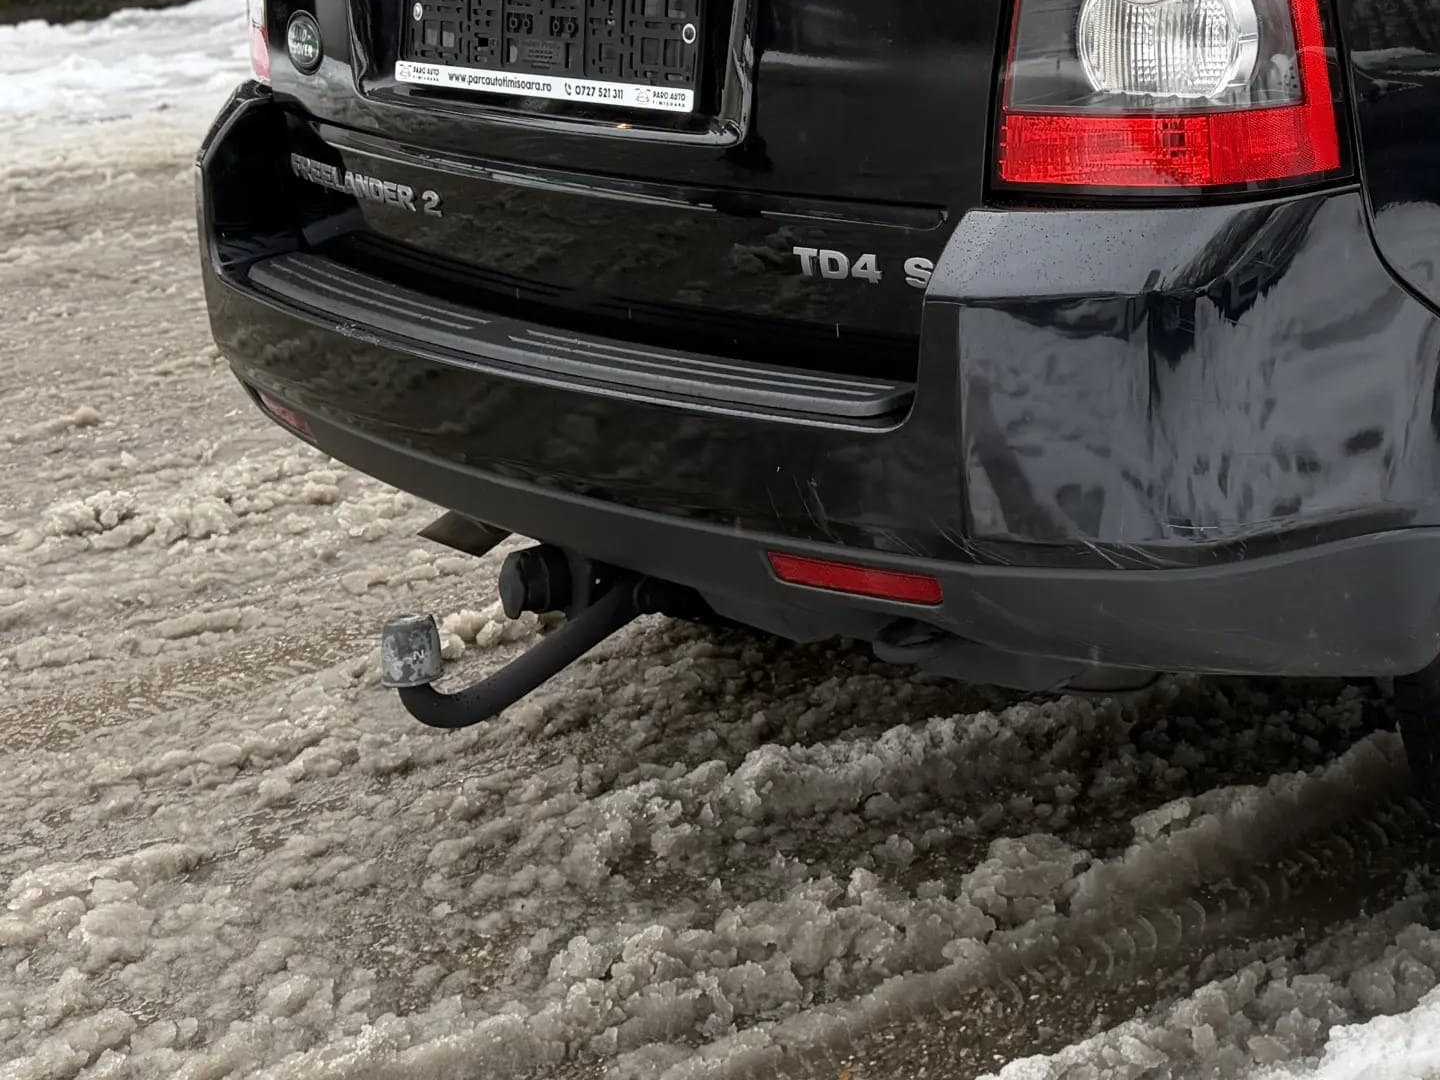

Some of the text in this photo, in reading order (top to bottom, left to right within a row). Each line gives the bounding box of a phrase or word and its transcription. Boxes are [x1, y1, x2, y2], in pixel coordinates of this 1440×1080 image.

[448, 71, 552, 92] www.parcautotimisoara.ro
[574, 85, 596, 97] 0727
[598, 87, 611, 98] 521
[291, 153, 443, 218] FREELANDER 2
[793, 246, 884, 284] TD4
